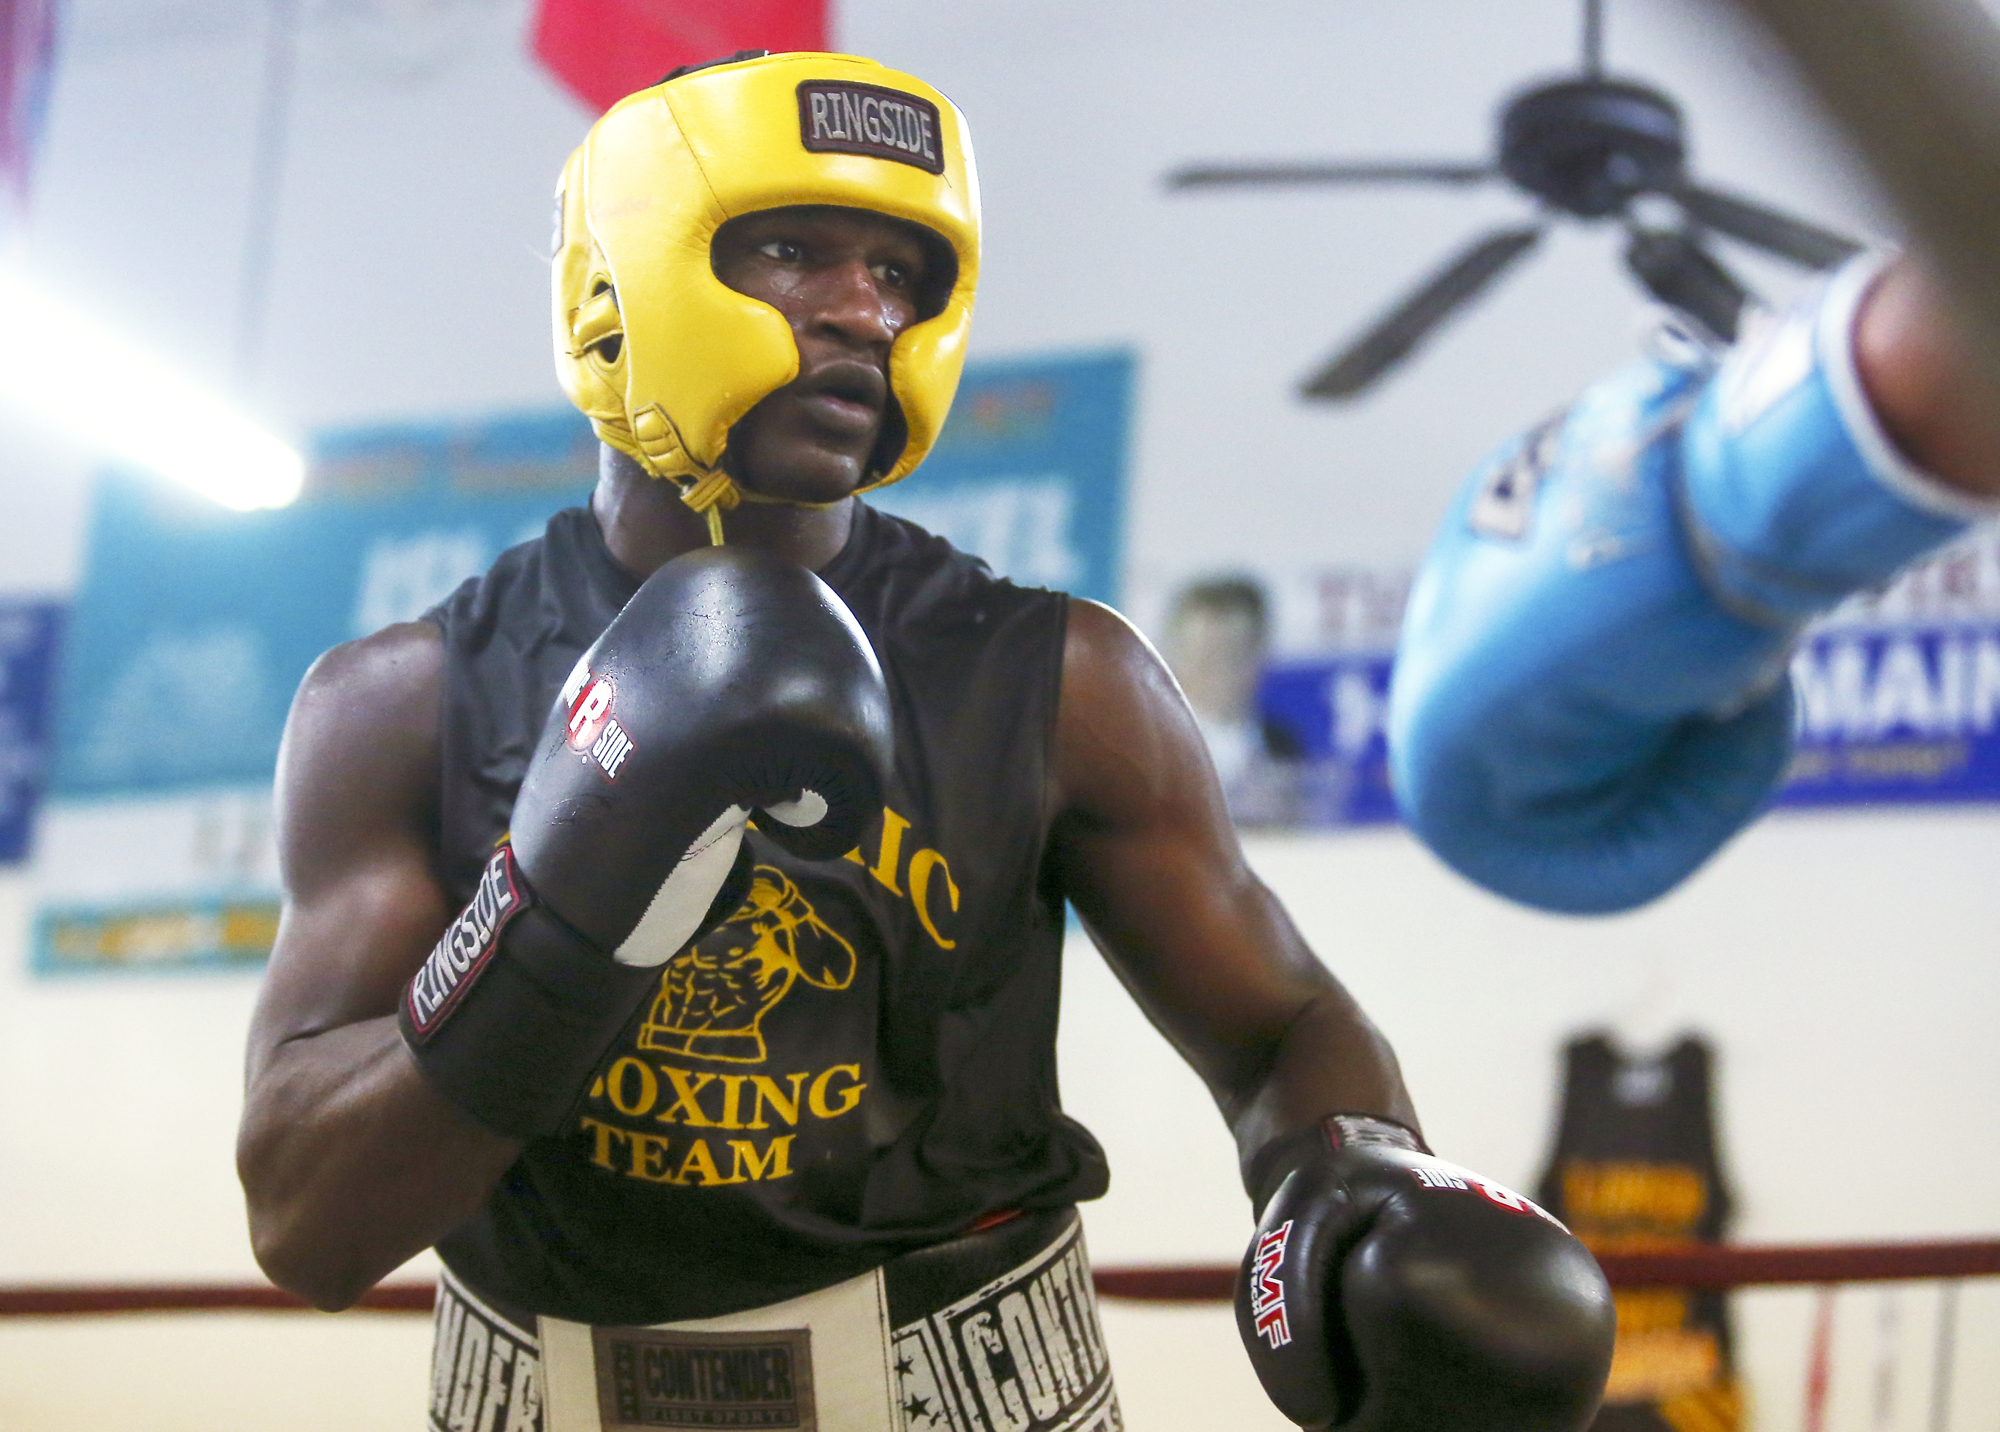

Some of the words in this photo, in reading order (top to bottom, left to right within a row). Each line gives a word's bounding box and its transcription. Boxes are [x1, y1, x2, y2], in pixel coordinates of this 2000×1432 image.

[809, 92, 936, 160] RINGSIDE
[592, 719, 635, 779] SIDE
[412, 851, 513, 1025] RINGSIDE
[589, 1056, 868, 1131] OXING
[580, 1115, 798, 1187] TEAM
[1411, 1167, 1469, 1191] SIDE
[1254, 1219, 1295, 1350] IMF
[642, 1346, 794, 1402] CONTENDER
